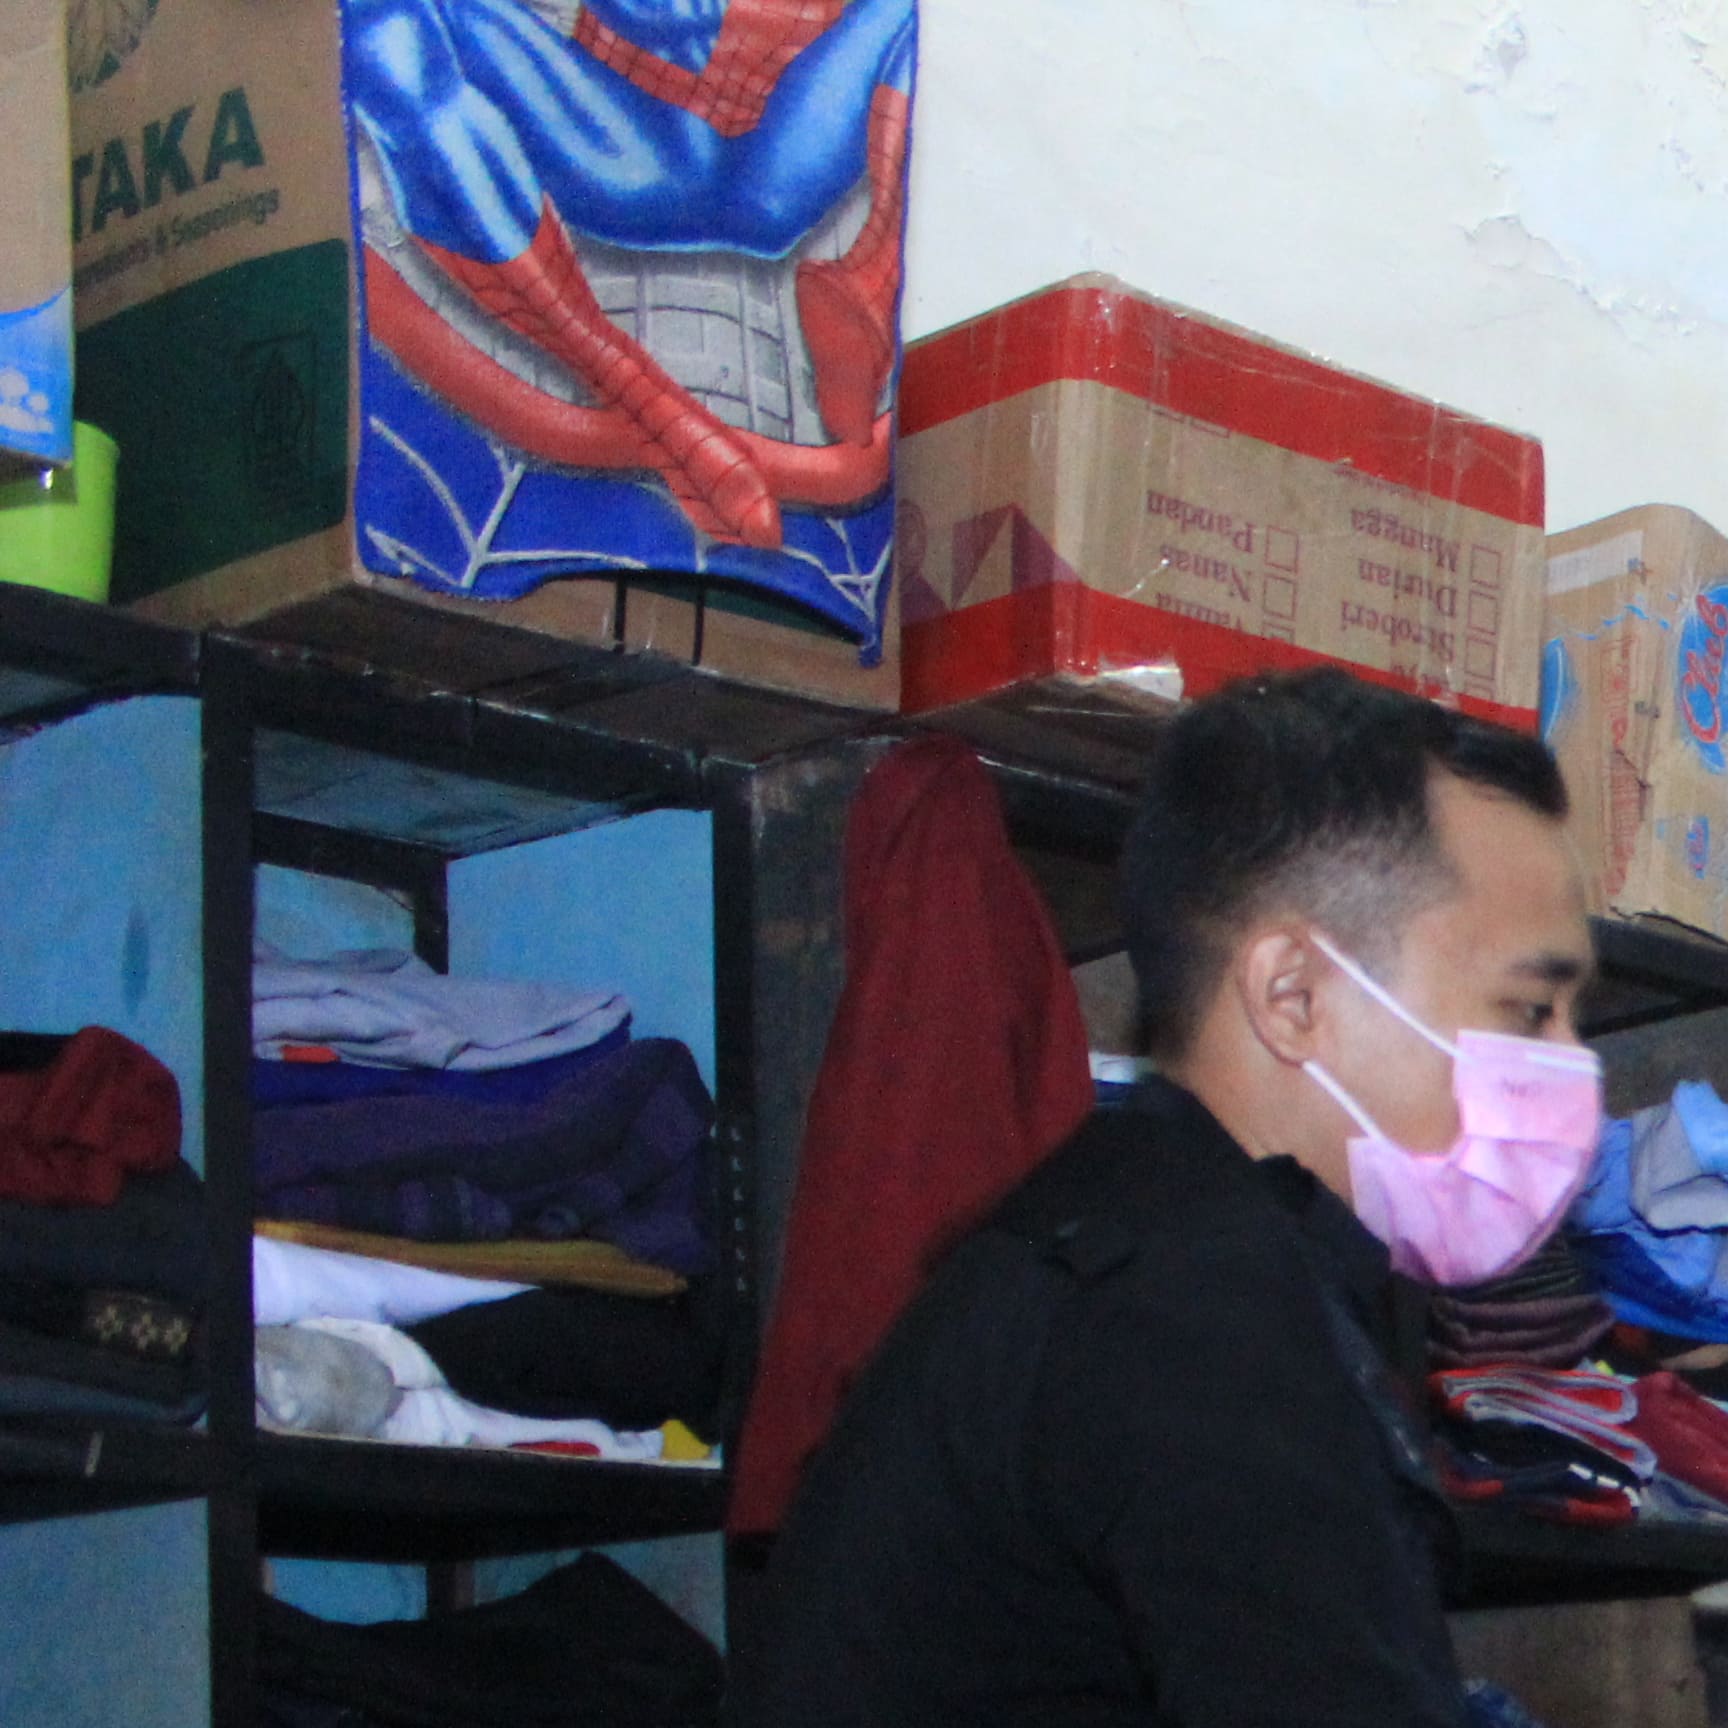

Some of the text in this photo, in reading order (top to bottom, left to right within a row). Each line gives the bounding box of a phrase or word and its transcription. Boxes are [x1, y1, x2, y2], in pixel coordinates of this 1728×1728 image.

[1146, 489, 1255, 554] Pandan
[1350, 507, 1461, 573] Mangga
[1160, 543, 1253, 603] Nanas
[1359, 557, 1457, 619] Durian
[1341, 600, 1456, 664] Stroberi
